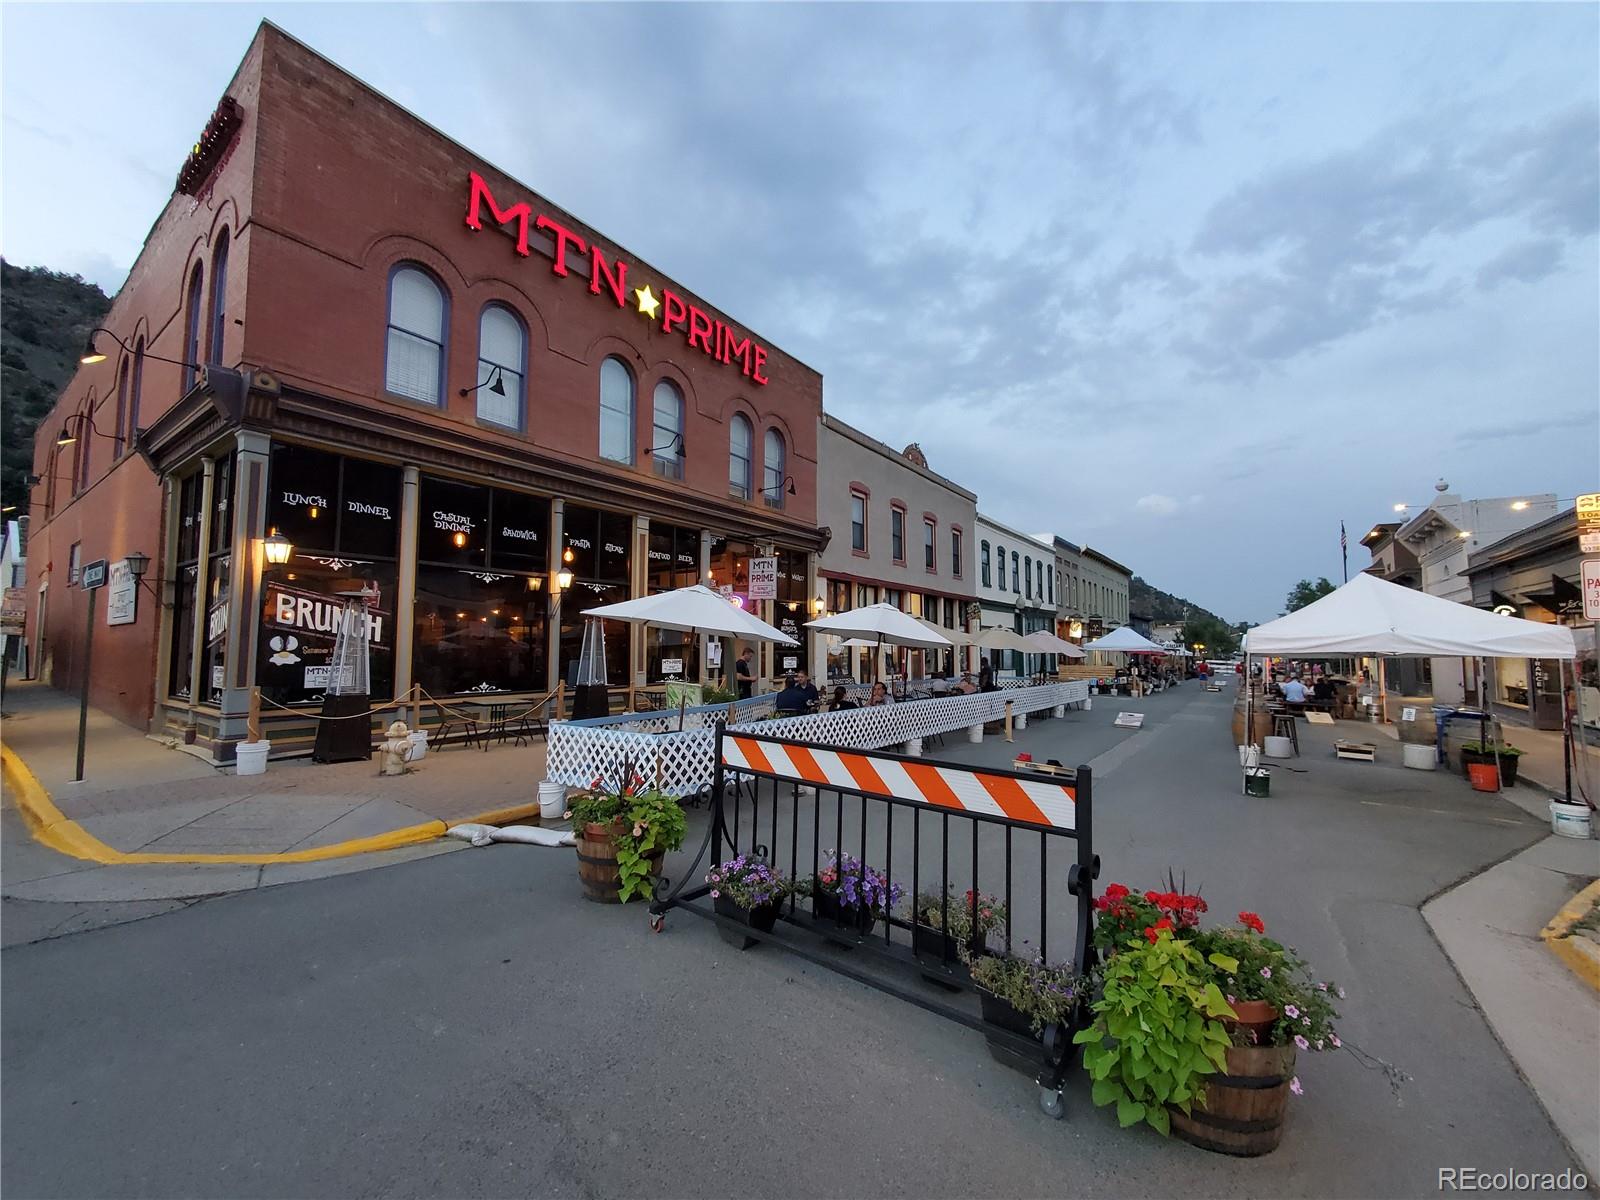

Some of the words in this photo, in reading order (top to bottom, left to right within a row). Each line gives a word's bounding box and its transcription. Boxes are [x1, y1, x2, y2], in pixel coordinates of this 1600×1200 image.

[465, 170, 627, 309] MTN
[661, 287, 769, 386] PRIME
[282, 491, 327, 508] LUNCH
[347, 500, 391, 520] DINNER
[433, 511, 475, 527] CASUAL
[434, 520, 471, 534] DINING
[502, 527, 537, 540] SANDWICH
[752, 560, 773, 570] MTN
[751, 574, 774, 582] PRIME
[276, 593, 383, 642] BRUNCH
[306, 667, 329, 675] MTN
